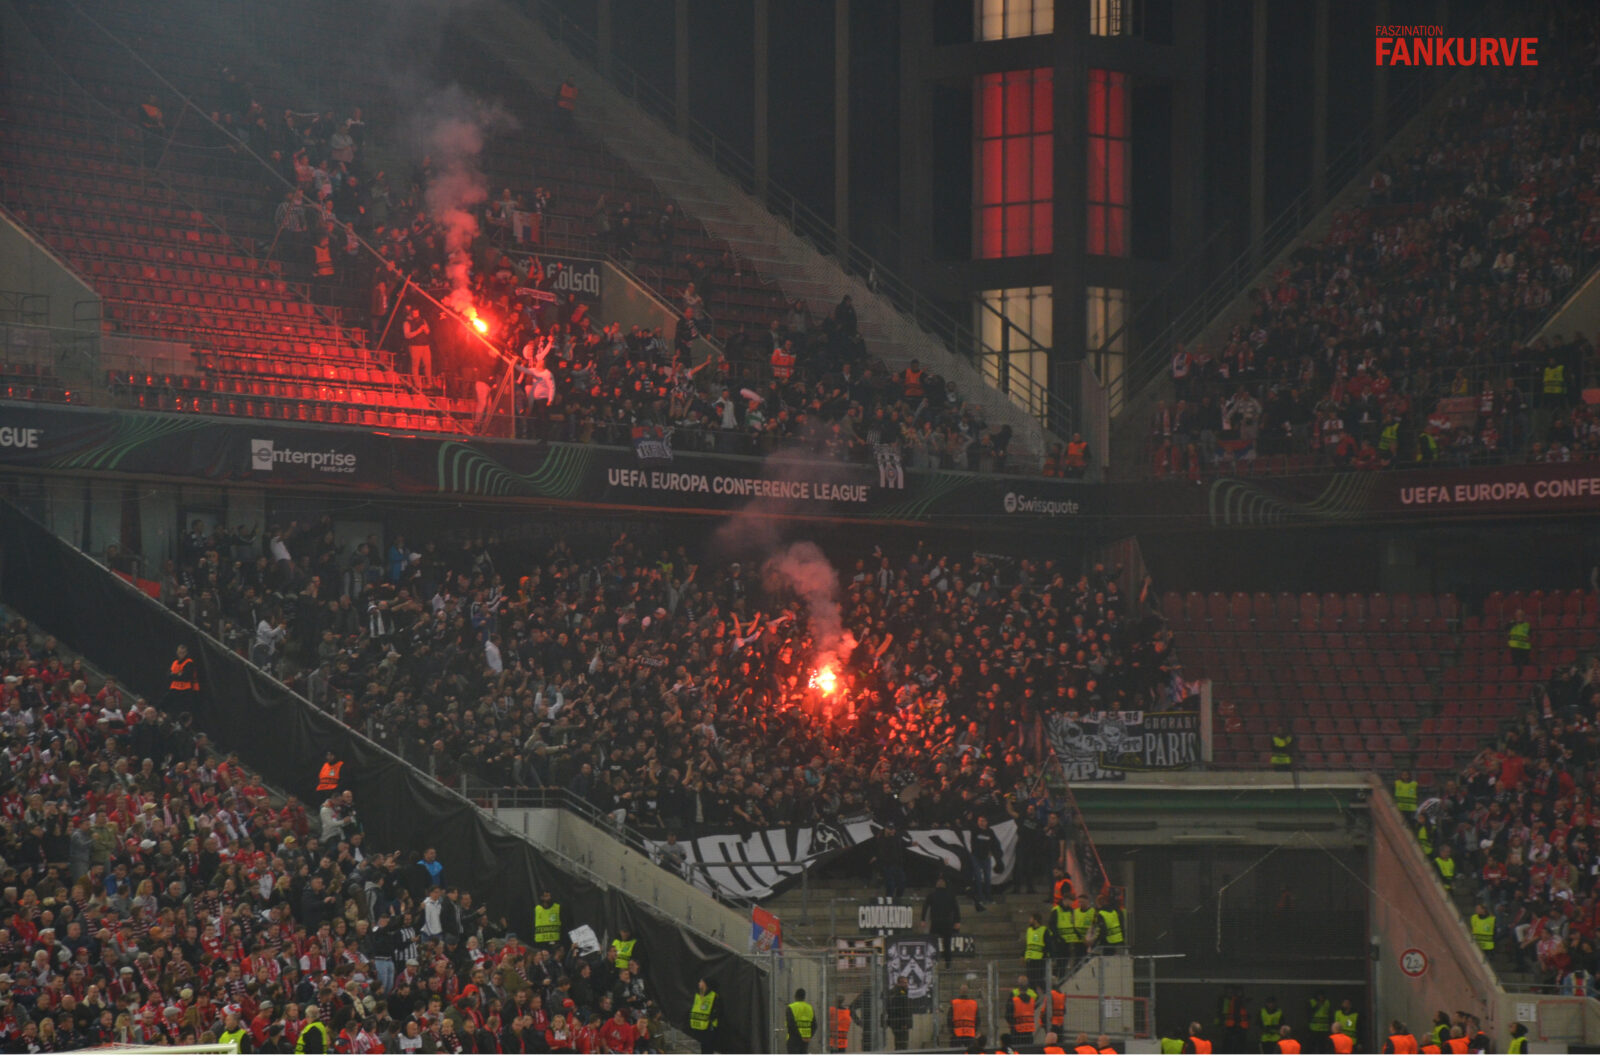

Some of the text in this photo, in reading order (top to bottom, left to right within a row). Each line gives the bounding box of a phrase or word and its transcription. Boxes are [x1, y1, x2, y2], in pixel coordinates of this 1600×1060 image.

[253, 446, 356, 469] enterprise
[608, 467, 868, 502] UEFA EUROPA CONFERENCE LEAGUE
[1400, 477, 1600, 504] UEFA EUROPA CONFE
[1018, 494, 1080, 517] Swissquote
[1144, 732, 1197, 766] PARIS
[858, 905, 913, 929] COMMANDO
